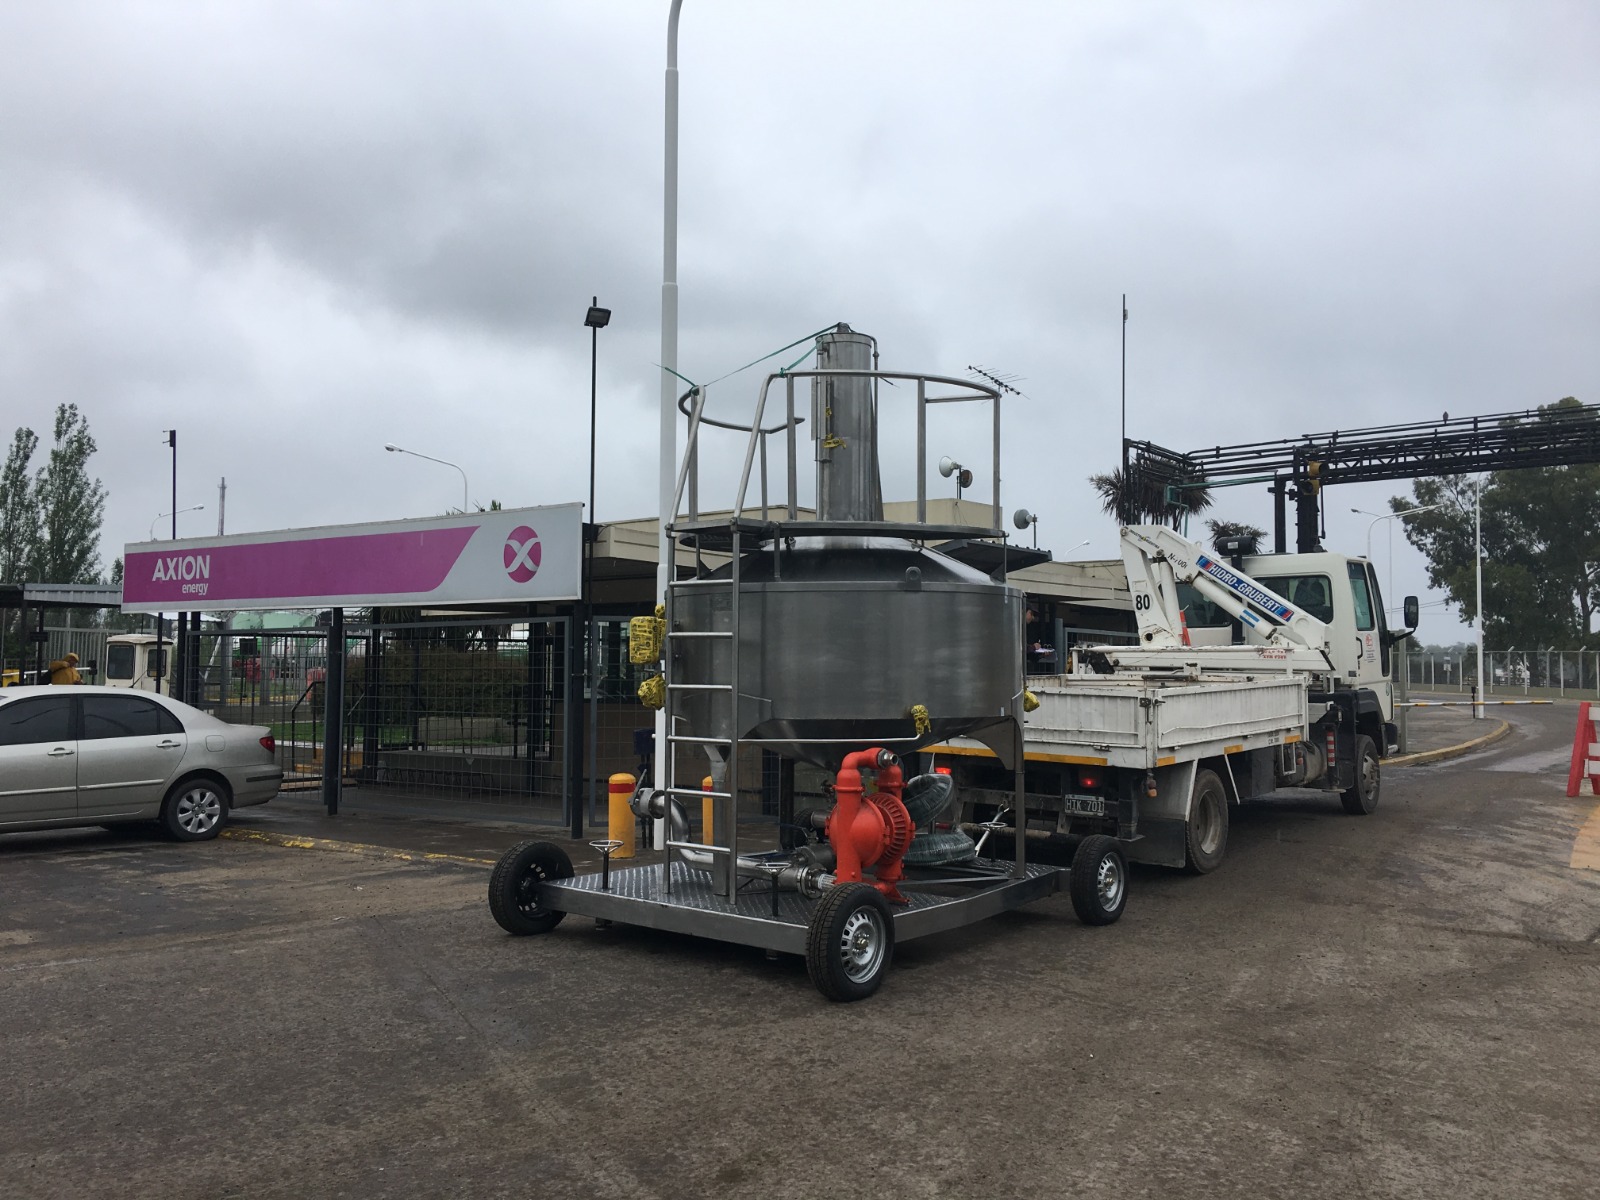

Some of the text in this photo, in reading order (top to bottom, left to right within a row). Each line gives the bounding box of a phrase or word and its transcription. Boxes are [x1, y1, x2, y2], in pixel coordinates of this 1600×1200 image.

[152, 555, 210, 581] AXION
[181, 583, 209, 596] energy
[1135, 594, 1151, 611] 80
